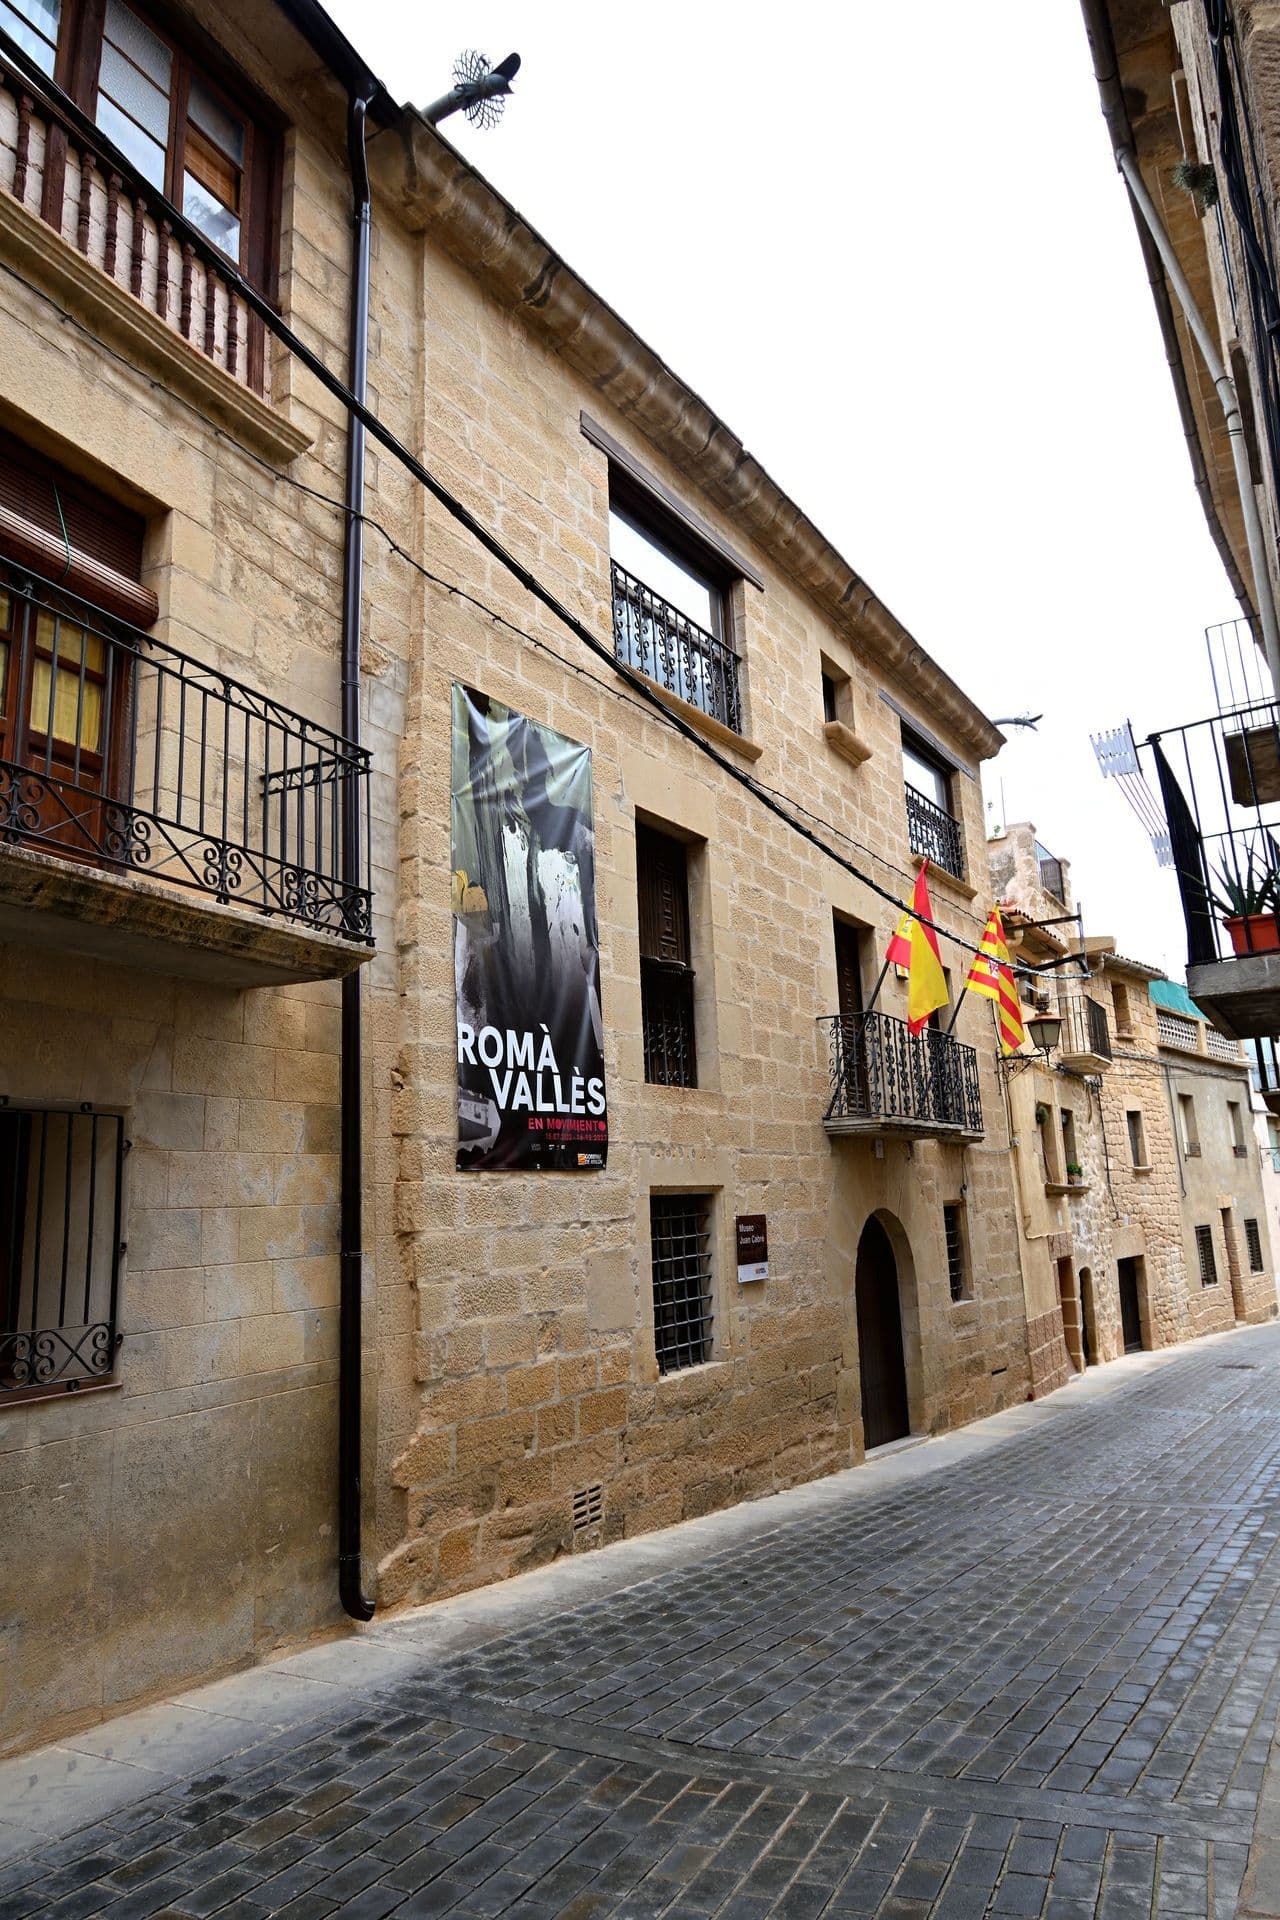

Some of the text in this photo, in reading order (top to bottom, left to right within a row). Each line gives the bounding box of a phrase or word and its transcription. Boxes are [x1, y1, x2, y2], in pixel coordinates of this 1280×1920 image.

[457, 1023, 559, 1073] ROMÀ
[489, 1067, 606, 1115] VALLÈS
[529, 1118, 606, 1131] EN MOVIMIENTO
[740, 1236, 751, 1245] Juan
